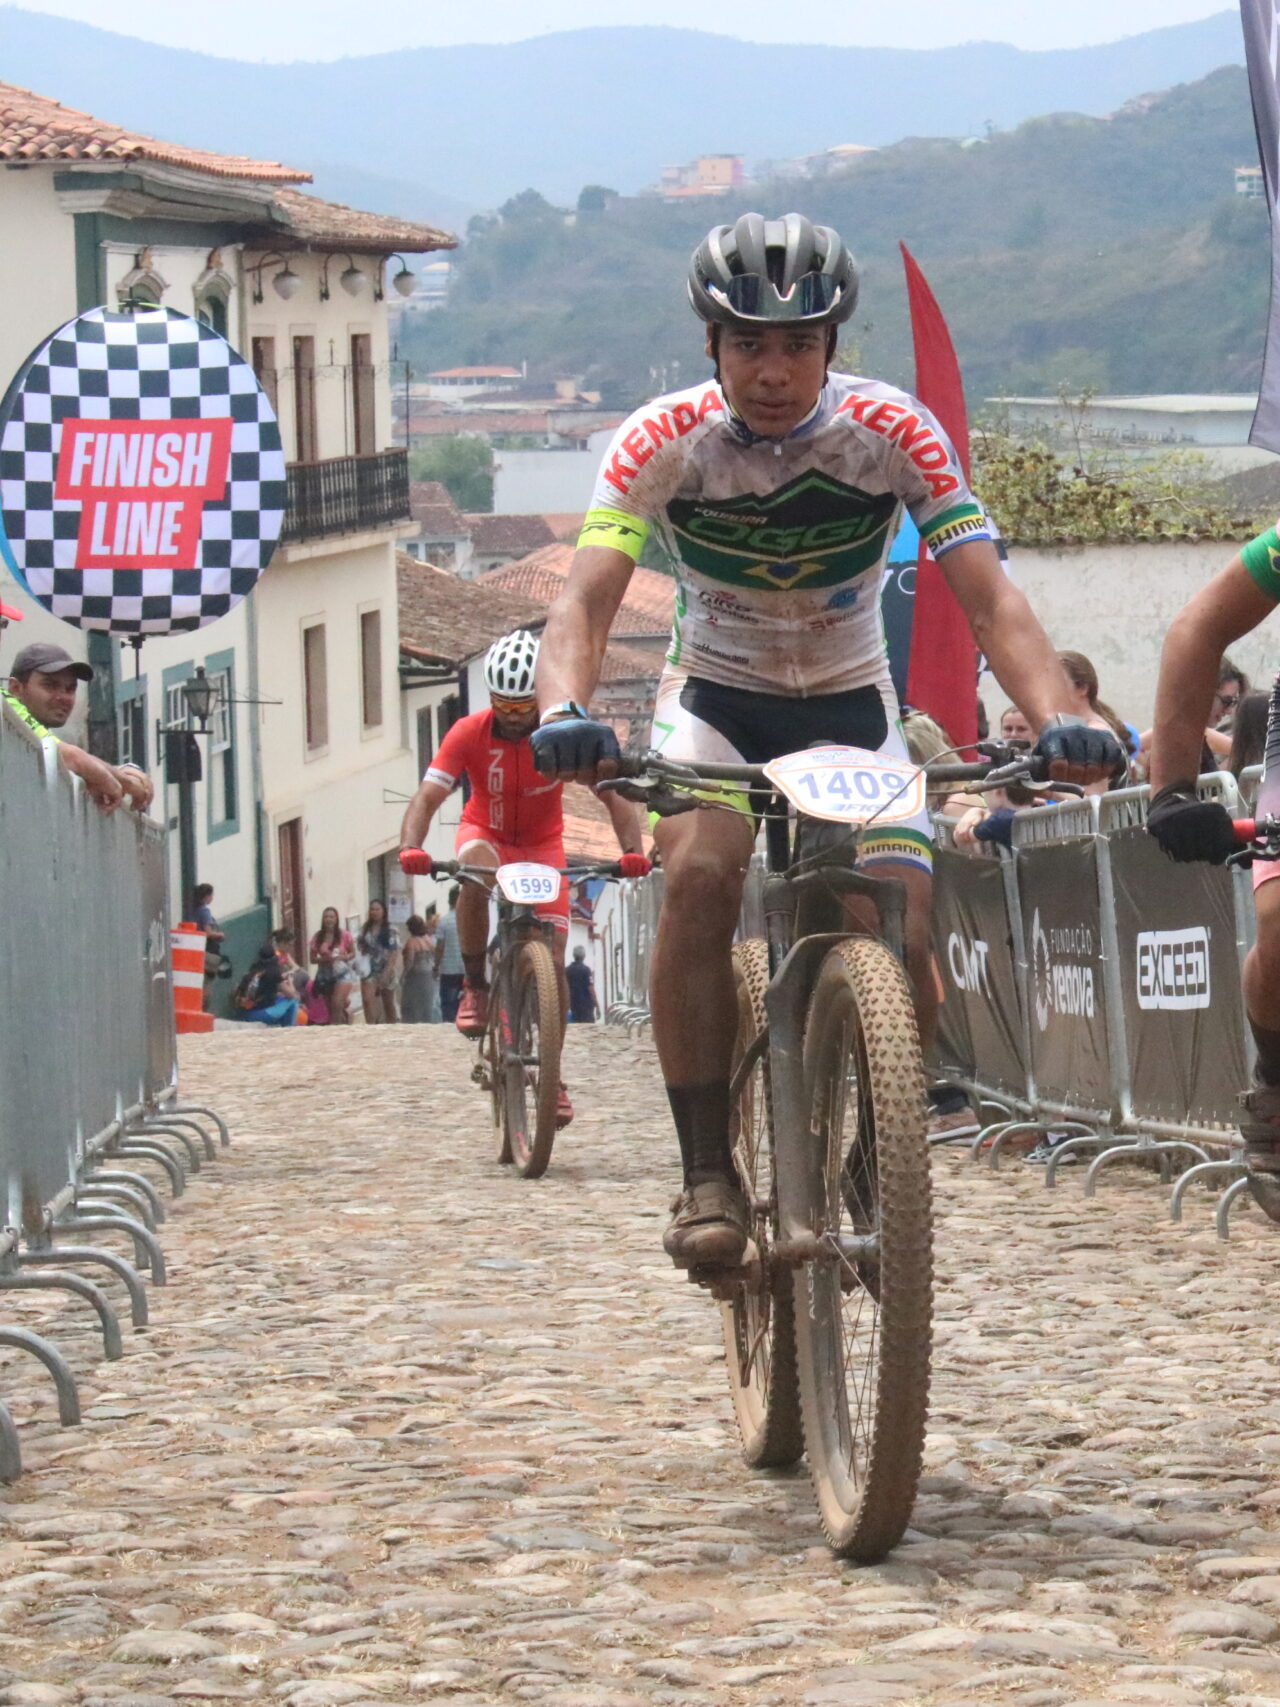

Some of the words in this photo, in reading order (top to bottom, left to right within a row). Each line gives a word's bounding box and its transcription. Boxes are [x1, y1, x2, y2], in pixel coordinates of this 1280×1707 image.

[69, 432, 213, 487] FINISH
[603, 388, 724, 495] KENDA
[838, 393, 960, 500] KENDA
[90, 501, 184, 556] LINE
[686, 514, 874, 551] OGGI
[927, 517, 988, 552] SHIMA
[797, 770, 909, 800] 1409
[510, 878, 553, 894] 1599
[948, 932, 992, 999] CMT
[1052, 964, 1095, 1018] renova
[1138, 939, 1209, 998] EXCEED
